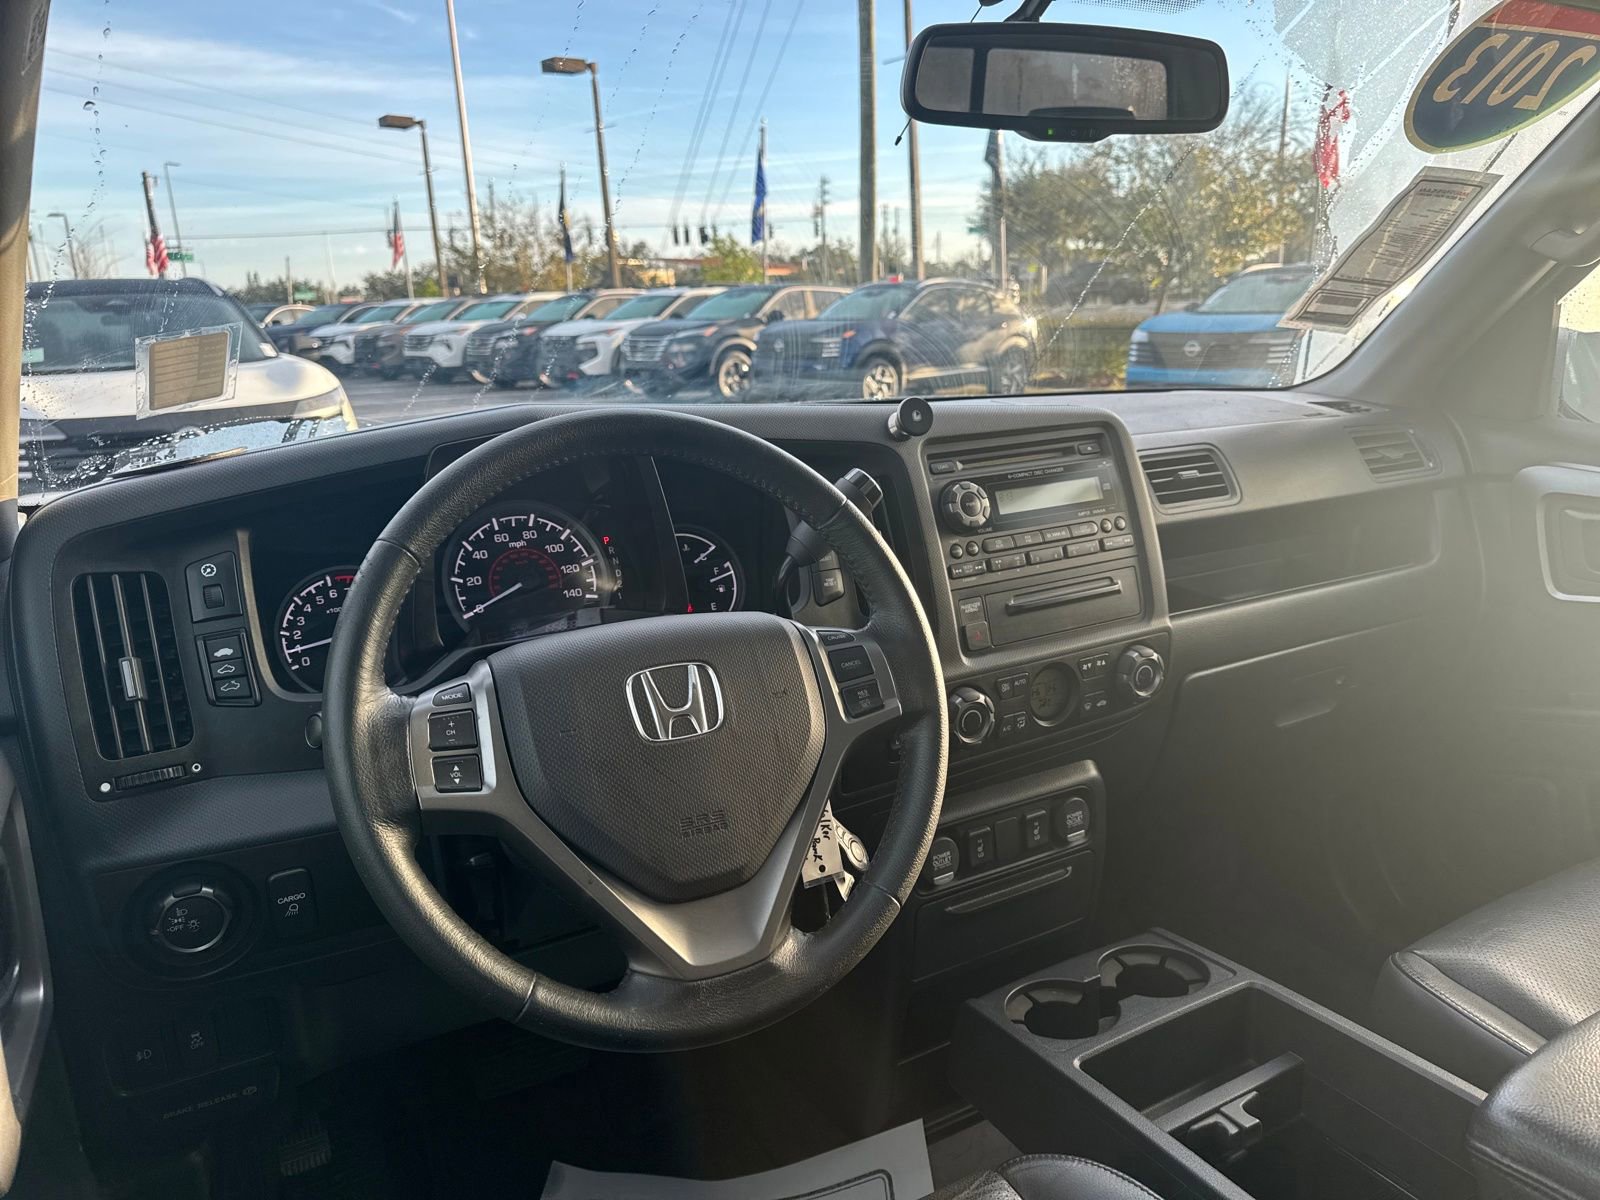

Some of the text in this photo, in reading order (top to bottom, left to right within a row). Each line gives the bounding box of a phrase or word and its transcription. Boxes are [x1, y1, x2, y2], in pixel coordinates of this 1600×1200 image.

[494, 533, 510, 543] 60
[522, 530, 538, 540] 80
[508, 540, 527, 549] mph
[603, 536, 610, 545] P
[544, 543, 564, 553] 100
[609, 546, 615, 554] R
[472, 550, 488, 560] 40
[560, 564, 580, 574] 120
[713, 566, 720, 575] F
[466, 576, 482, 586] 20
[329, 589, 338, 598] 6
[563, 588, 583, 598] 140
[316, 595, 325, 605] 5
[303, 603, 312, 612] 4
[476, 604, 484, 613] 0
[710, 602, 717, 611] E
[296, 616, 305, 626] 3
[293, 630, 302, 640] 2
[301, 656, 310, 666] 0
[840, 659, 862, 669] CANCEL
[1014, 678, 1026, 686] AUTO
[441, 692, 464, 700] MODE
[933, 850, 950, 860] POWER
[277, 892, 306, 904] CARGO
[170, 924, 184, 933] OFF
